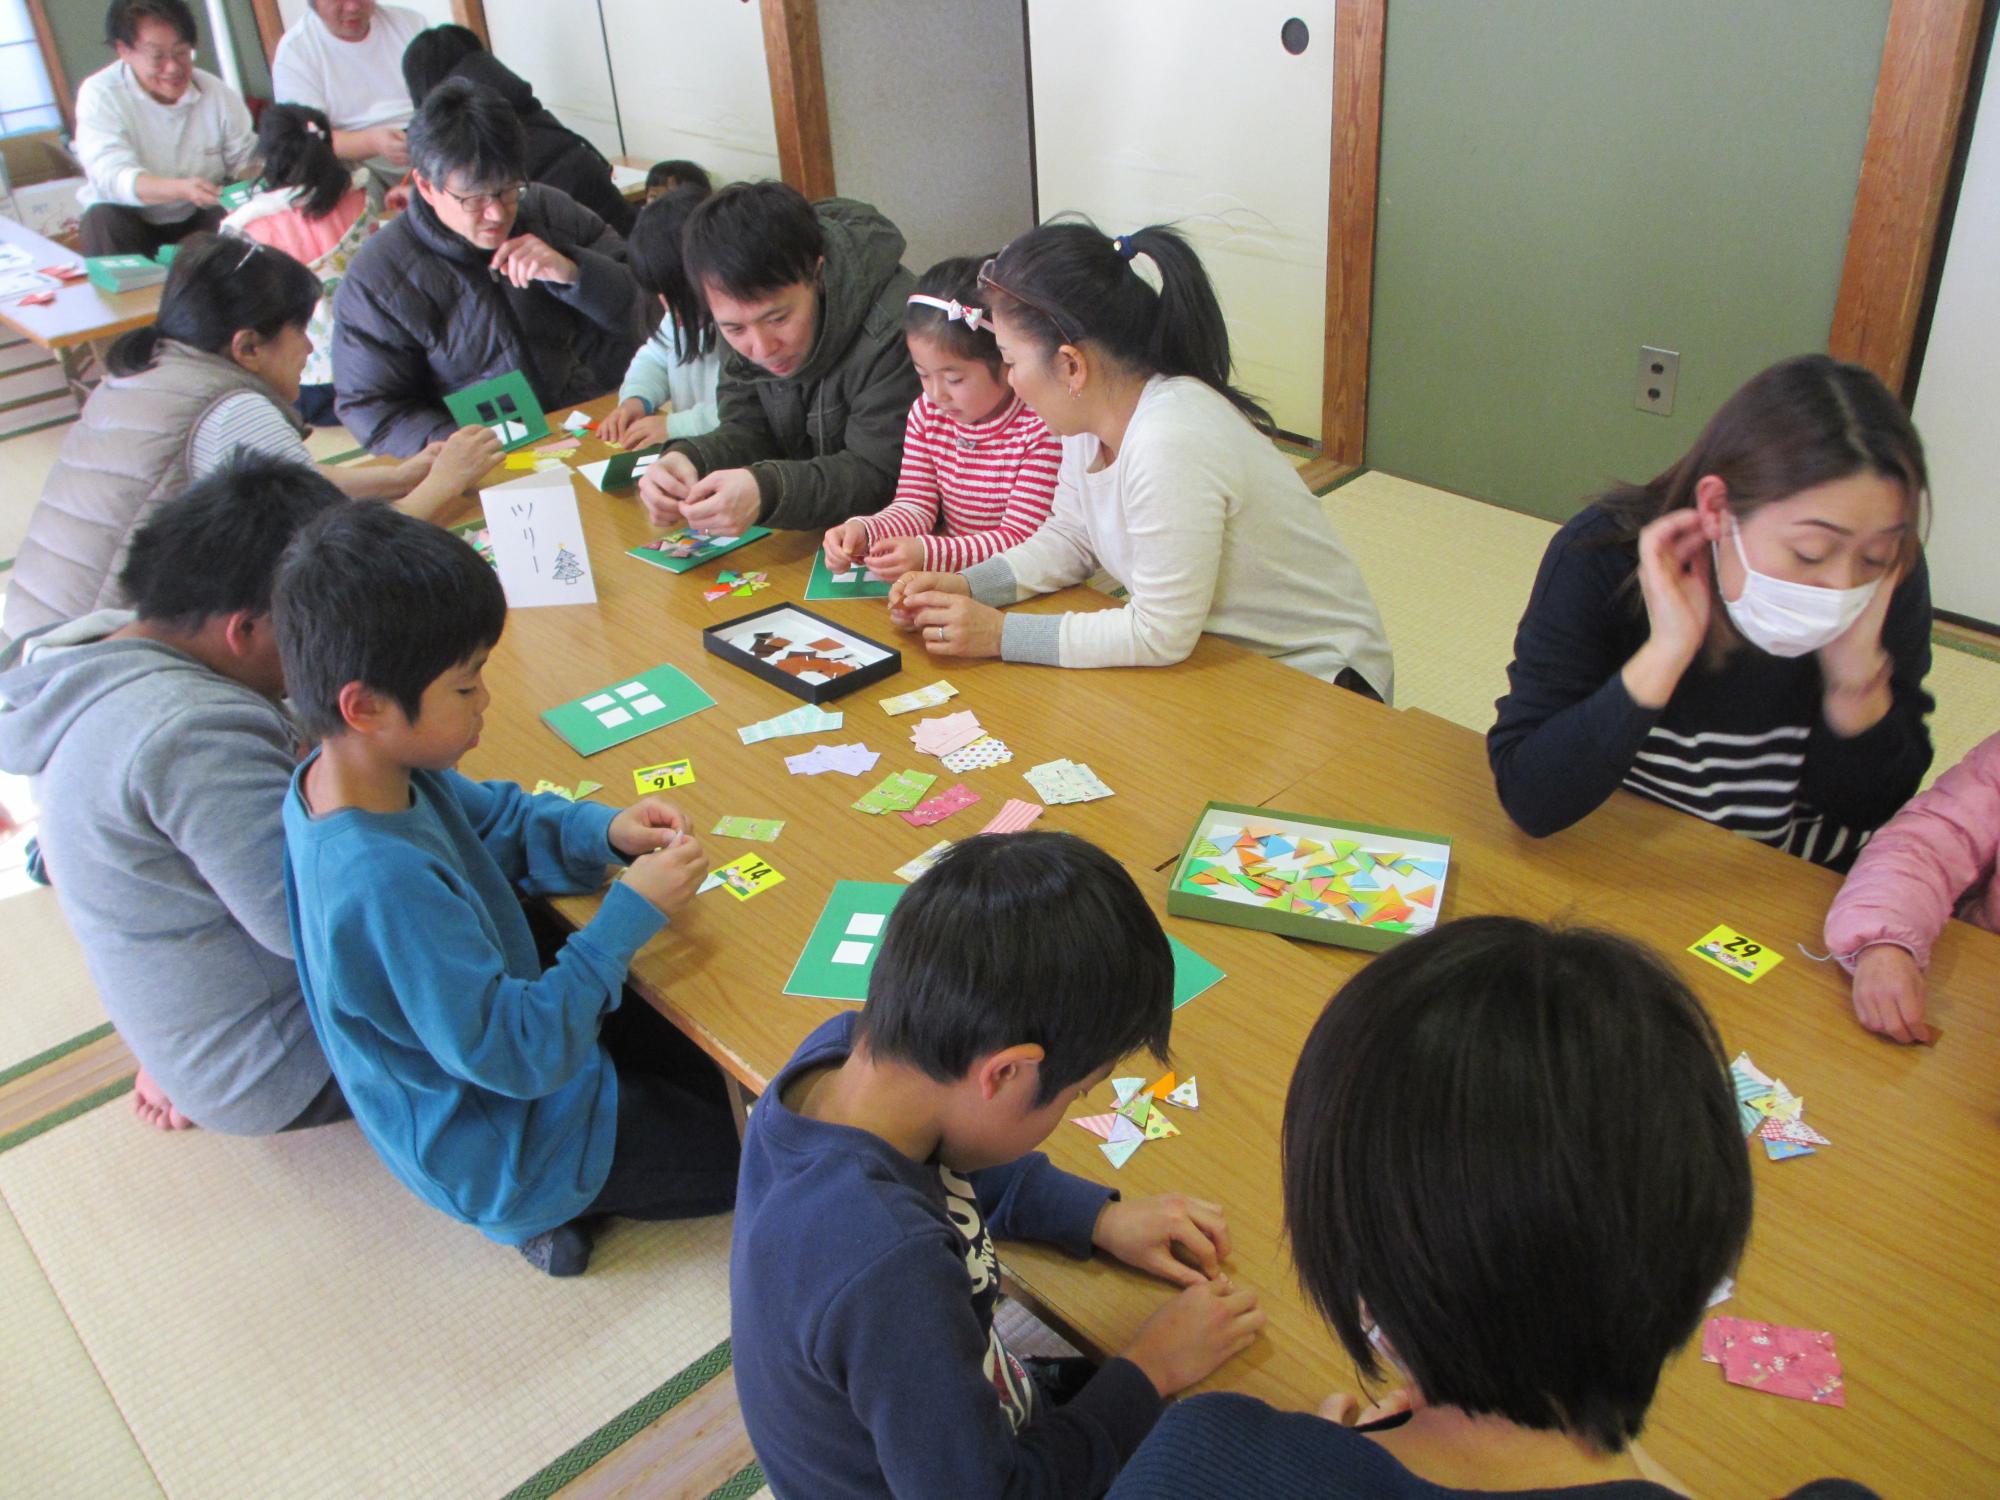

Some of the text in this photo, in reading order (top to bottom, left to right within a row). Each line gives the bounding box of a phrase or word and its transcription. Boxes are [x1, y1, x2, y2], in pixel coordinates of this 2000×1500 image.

[653, 774, 677, 789] 16
[742, 861, 772, 881] 14
[1723, 936, 1762, 958] 29
